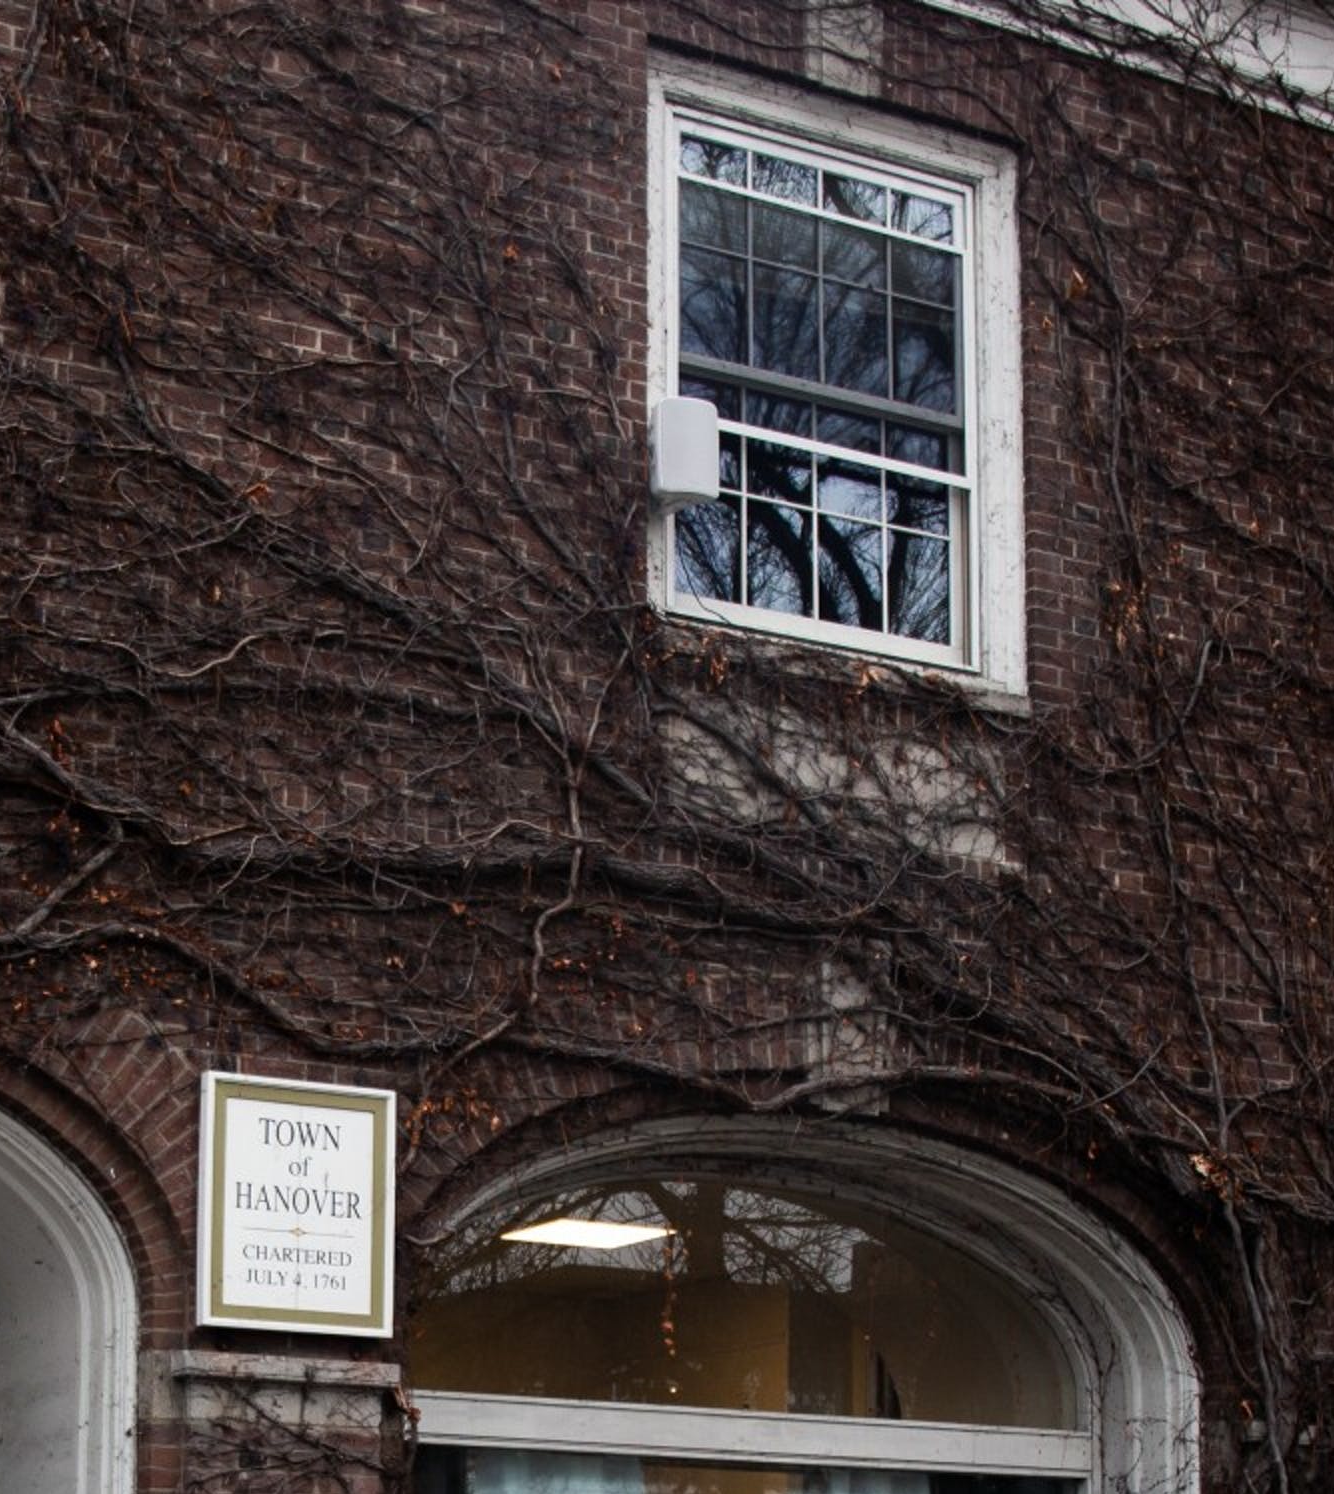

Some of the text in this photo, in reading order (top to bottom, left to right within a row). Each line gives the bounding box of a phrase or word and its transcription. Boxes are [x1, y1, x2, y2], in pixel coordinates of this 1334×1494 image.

[259, 1117, 341, 1151] TOWN
[288, 1156, 314, 1177] of
[234, 1181, 363, 1220] HANOVER
[242, 1244, 352, 1267] CHARTERED
[245, 1268, 288, 1287] JULY
[313, 1273, 347, 1291] 1761
